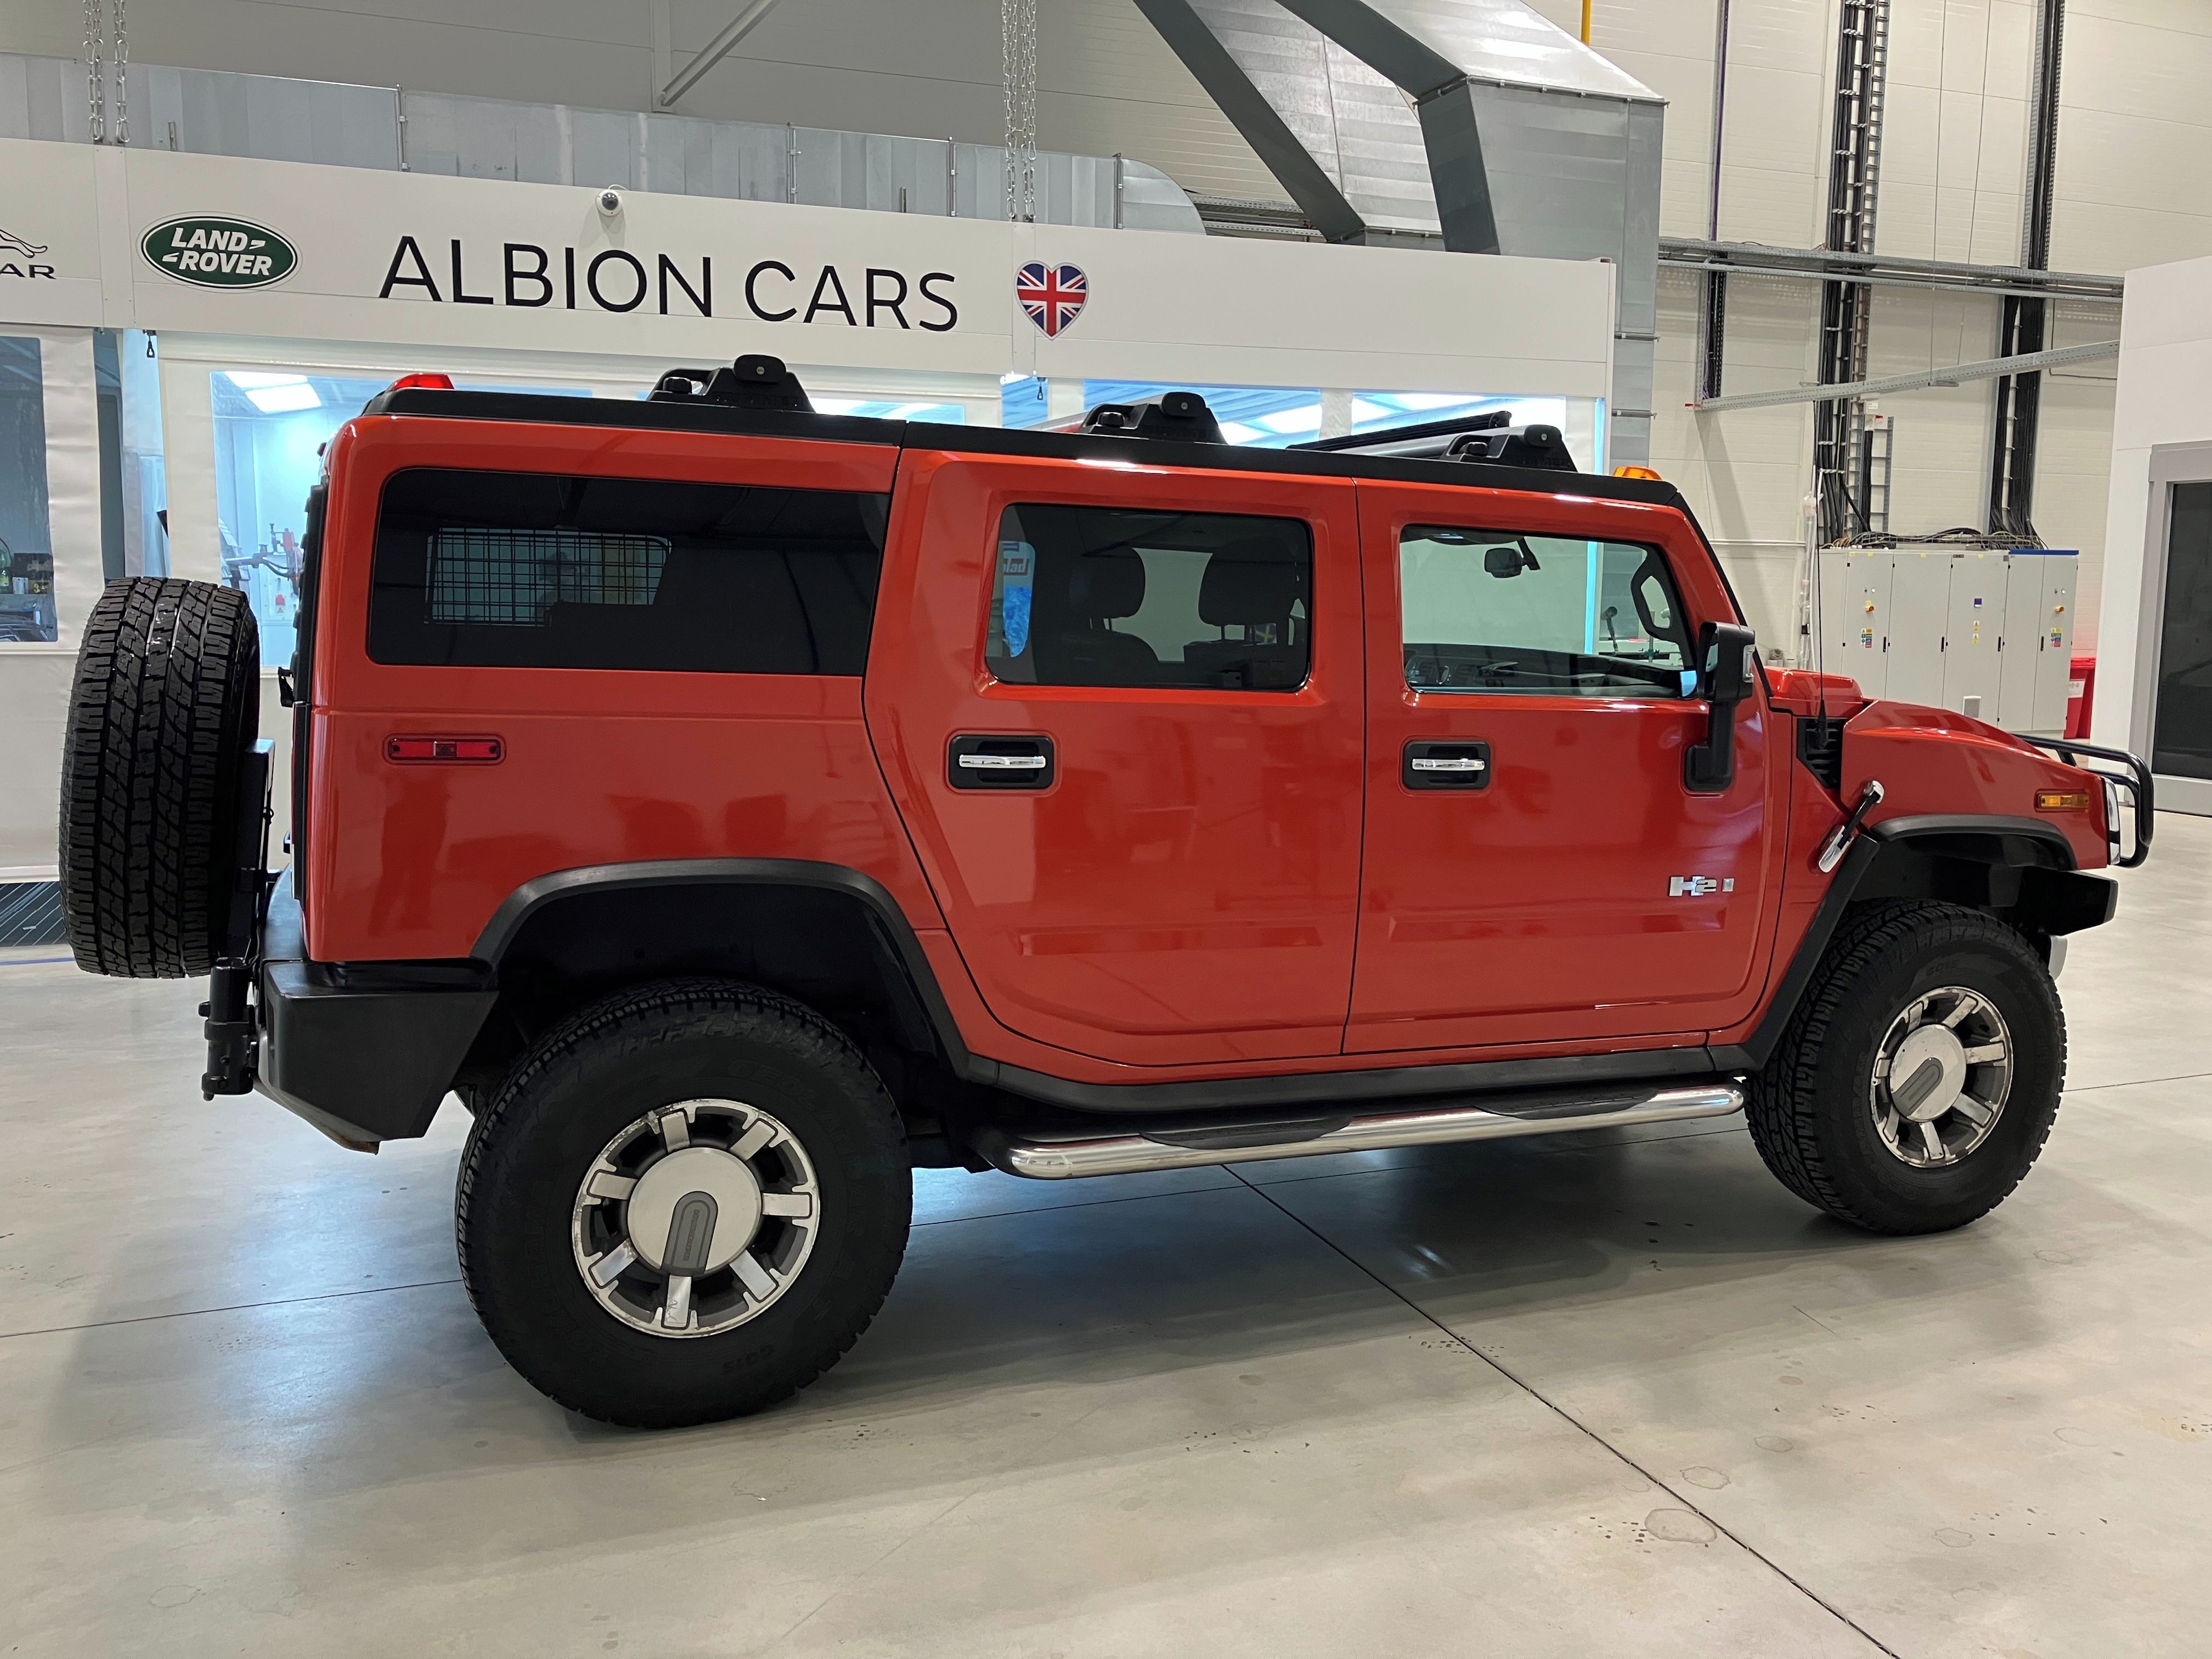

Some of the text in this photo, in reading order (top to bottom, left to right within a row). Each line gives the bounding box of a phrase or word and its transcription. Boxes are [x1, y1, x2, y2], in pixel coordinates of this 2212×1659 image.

[171, 227, 248, 251] LAND
[179, 250, 272, 275] ROVER
[379, 236, 958, 332] ALBION CARS
